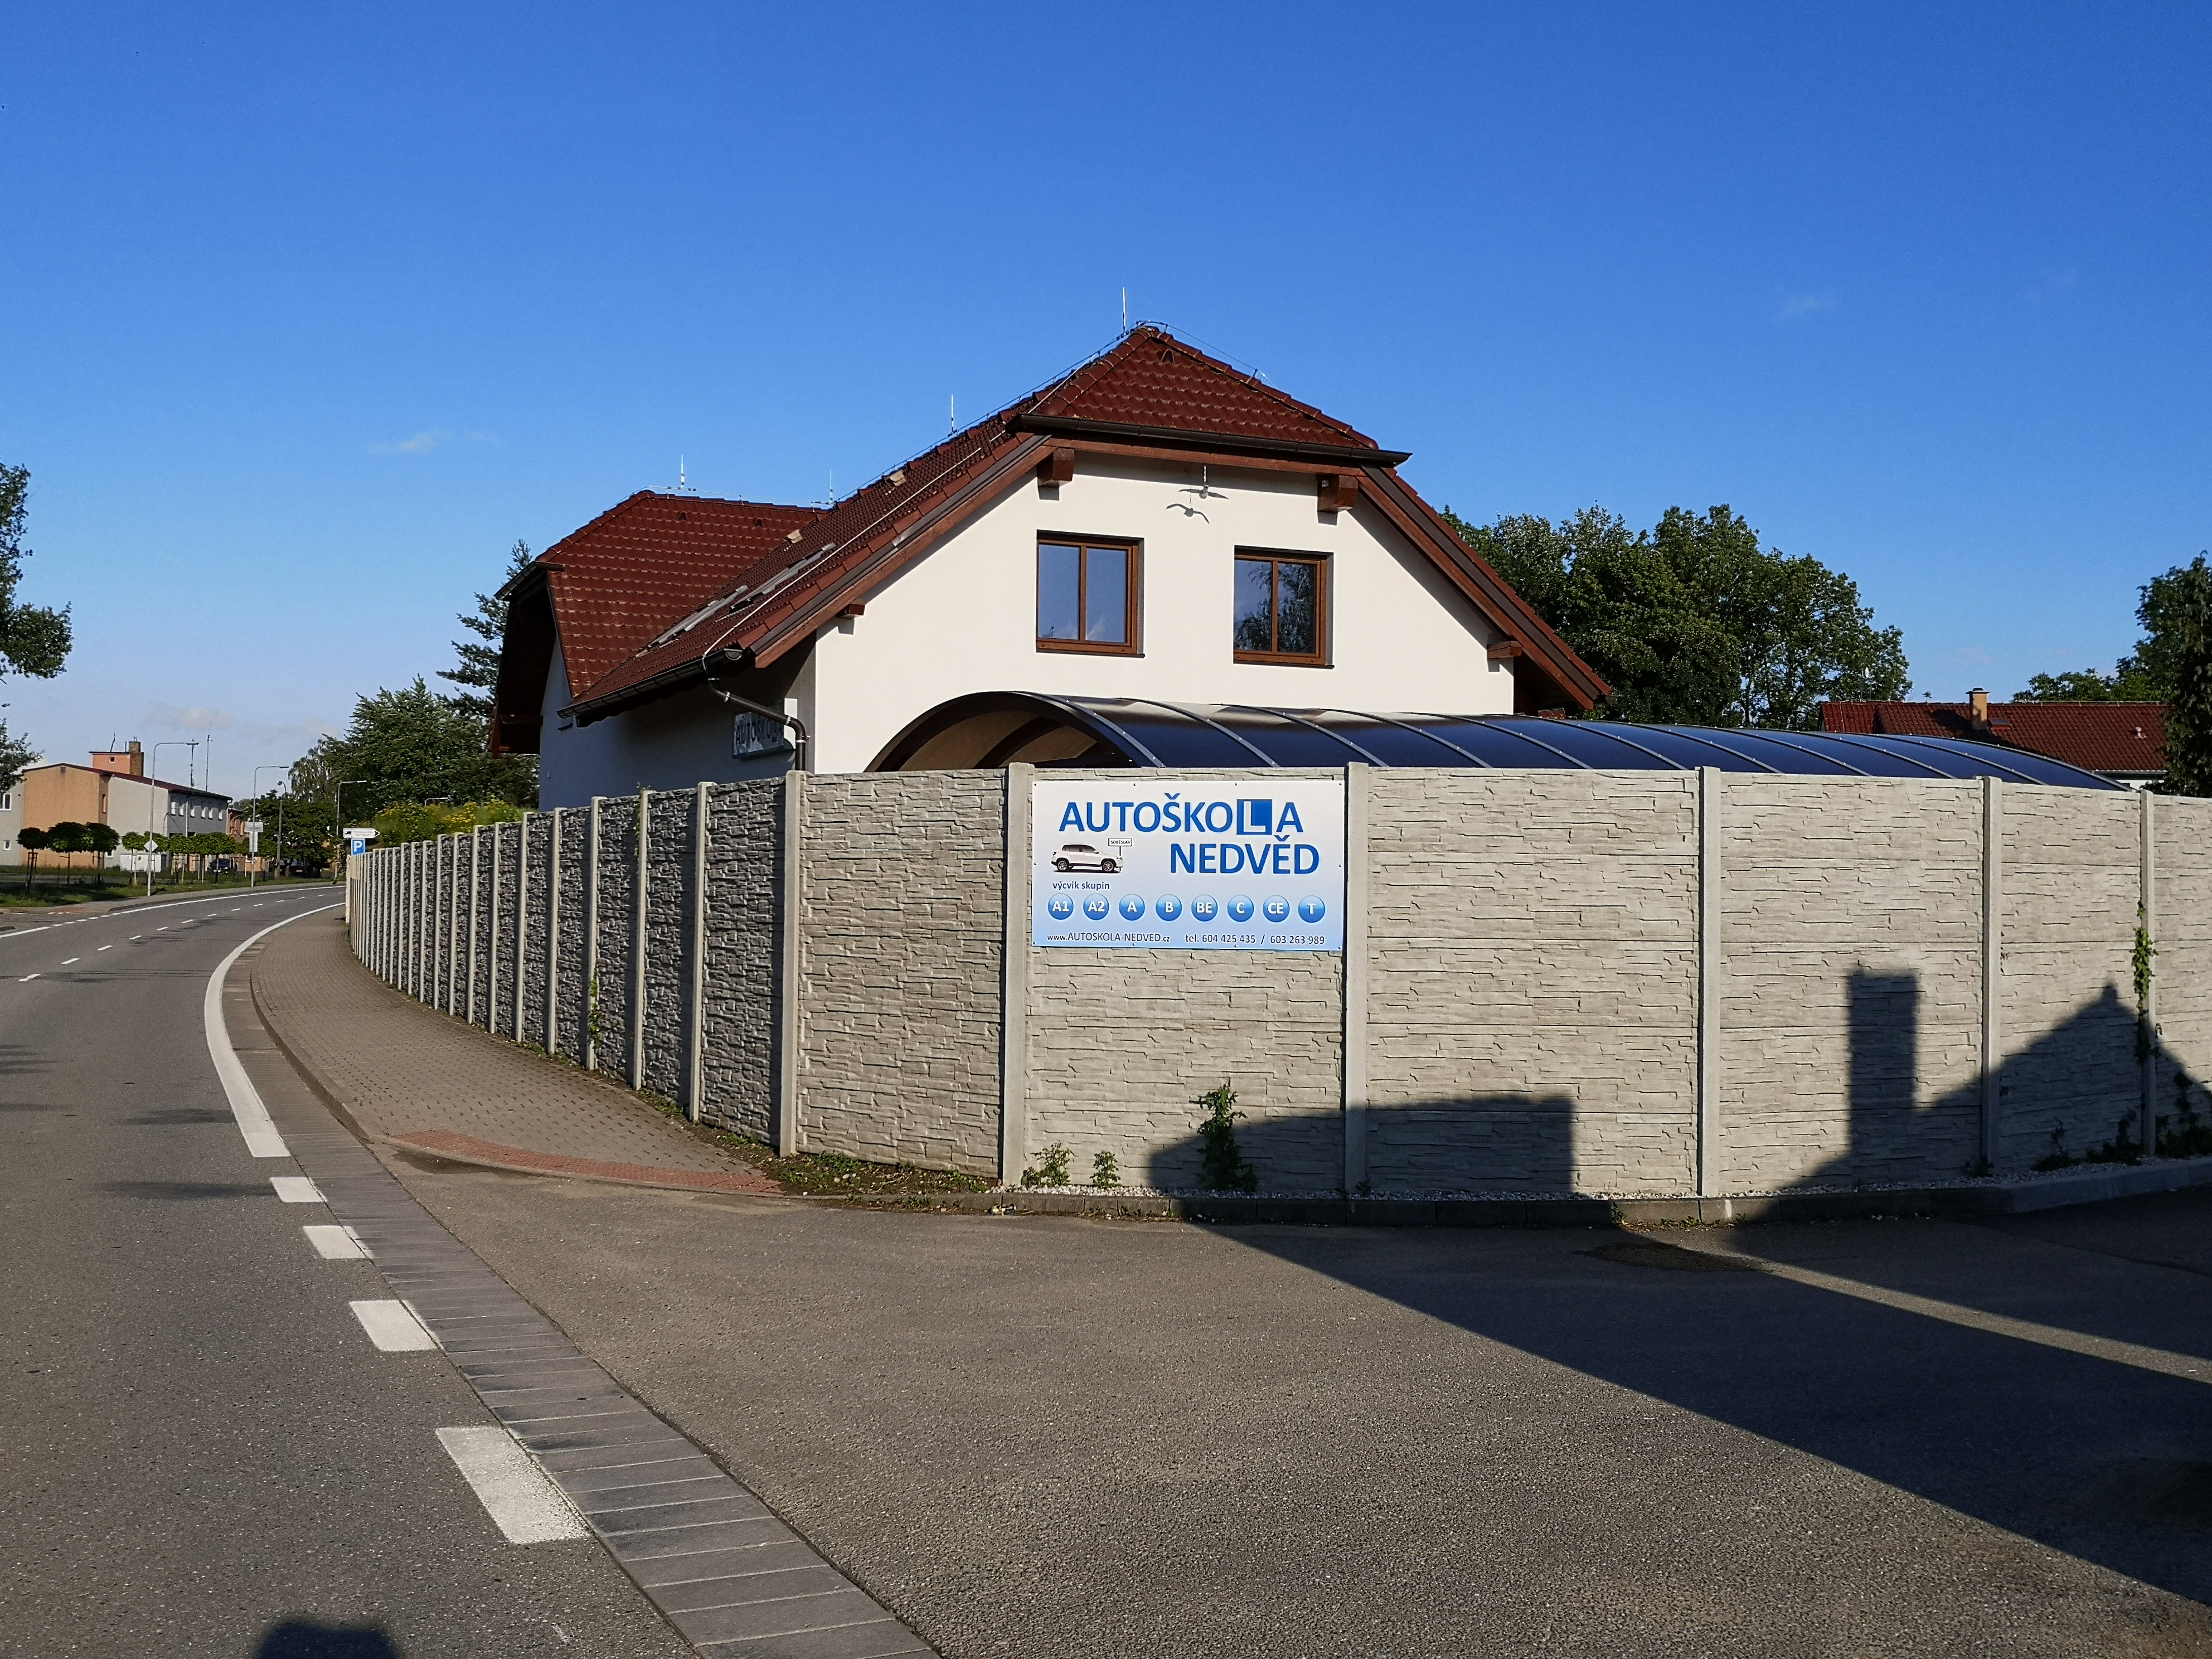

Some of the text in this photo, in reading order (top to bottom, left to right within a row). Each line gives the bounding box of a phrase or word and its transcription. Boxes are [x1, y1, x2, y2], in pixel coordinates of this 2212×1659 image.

[1059, 793, 1303, 835] AUTOŠKOLA
[354, 840, 362, 852] P
[1171, 835, 1320, 874] NEDVĚD
[1052, 881, 1110, 891] výcvik skupin
[1052, 900, 1316, 914] A1 A2 A B BE C CE T
[1047, 932, 1170, 942] www.AUTOSKOLA-NEDVED.cz
[1185, 934, 1199, 943] tel.
[1202, 934, 1218, 943] 604
[1221, 934, 1236, 943] 425
[1239, 935, 1255, 943] 435
[1270, 935, 1286, 944] 603
[1289, 935, 1306, 944] 263
[1308, 935, 1325, 944] 989
